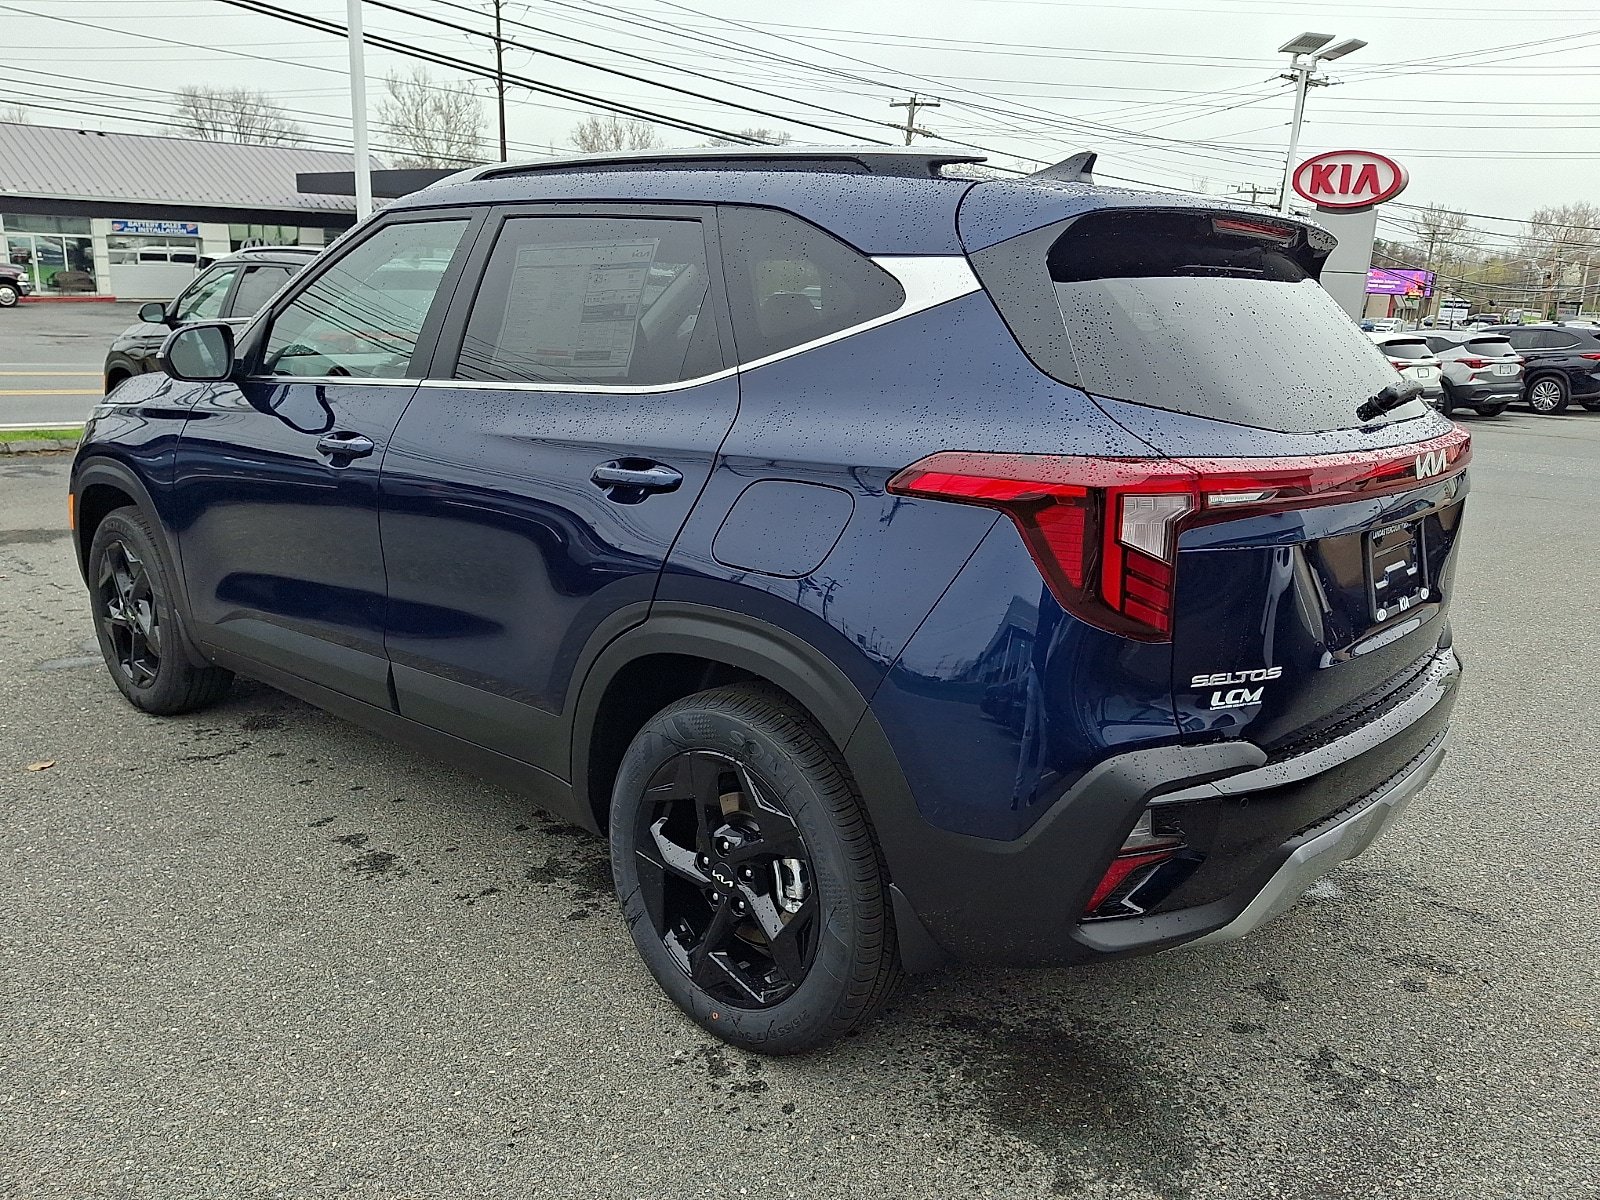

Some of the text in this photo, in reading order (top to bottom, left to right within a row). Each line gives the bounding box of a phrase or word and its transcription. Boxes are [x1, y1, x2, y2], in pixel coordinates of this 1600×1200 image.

[1309, 164, 1381, 195] KIA
[1416, 449, 1447, 480] KIA
[1399, 596, 1410, 611] KIA
[1191, 666, 1283, 688] SELTOS
[1210, 687, 1264, 707] LCM
